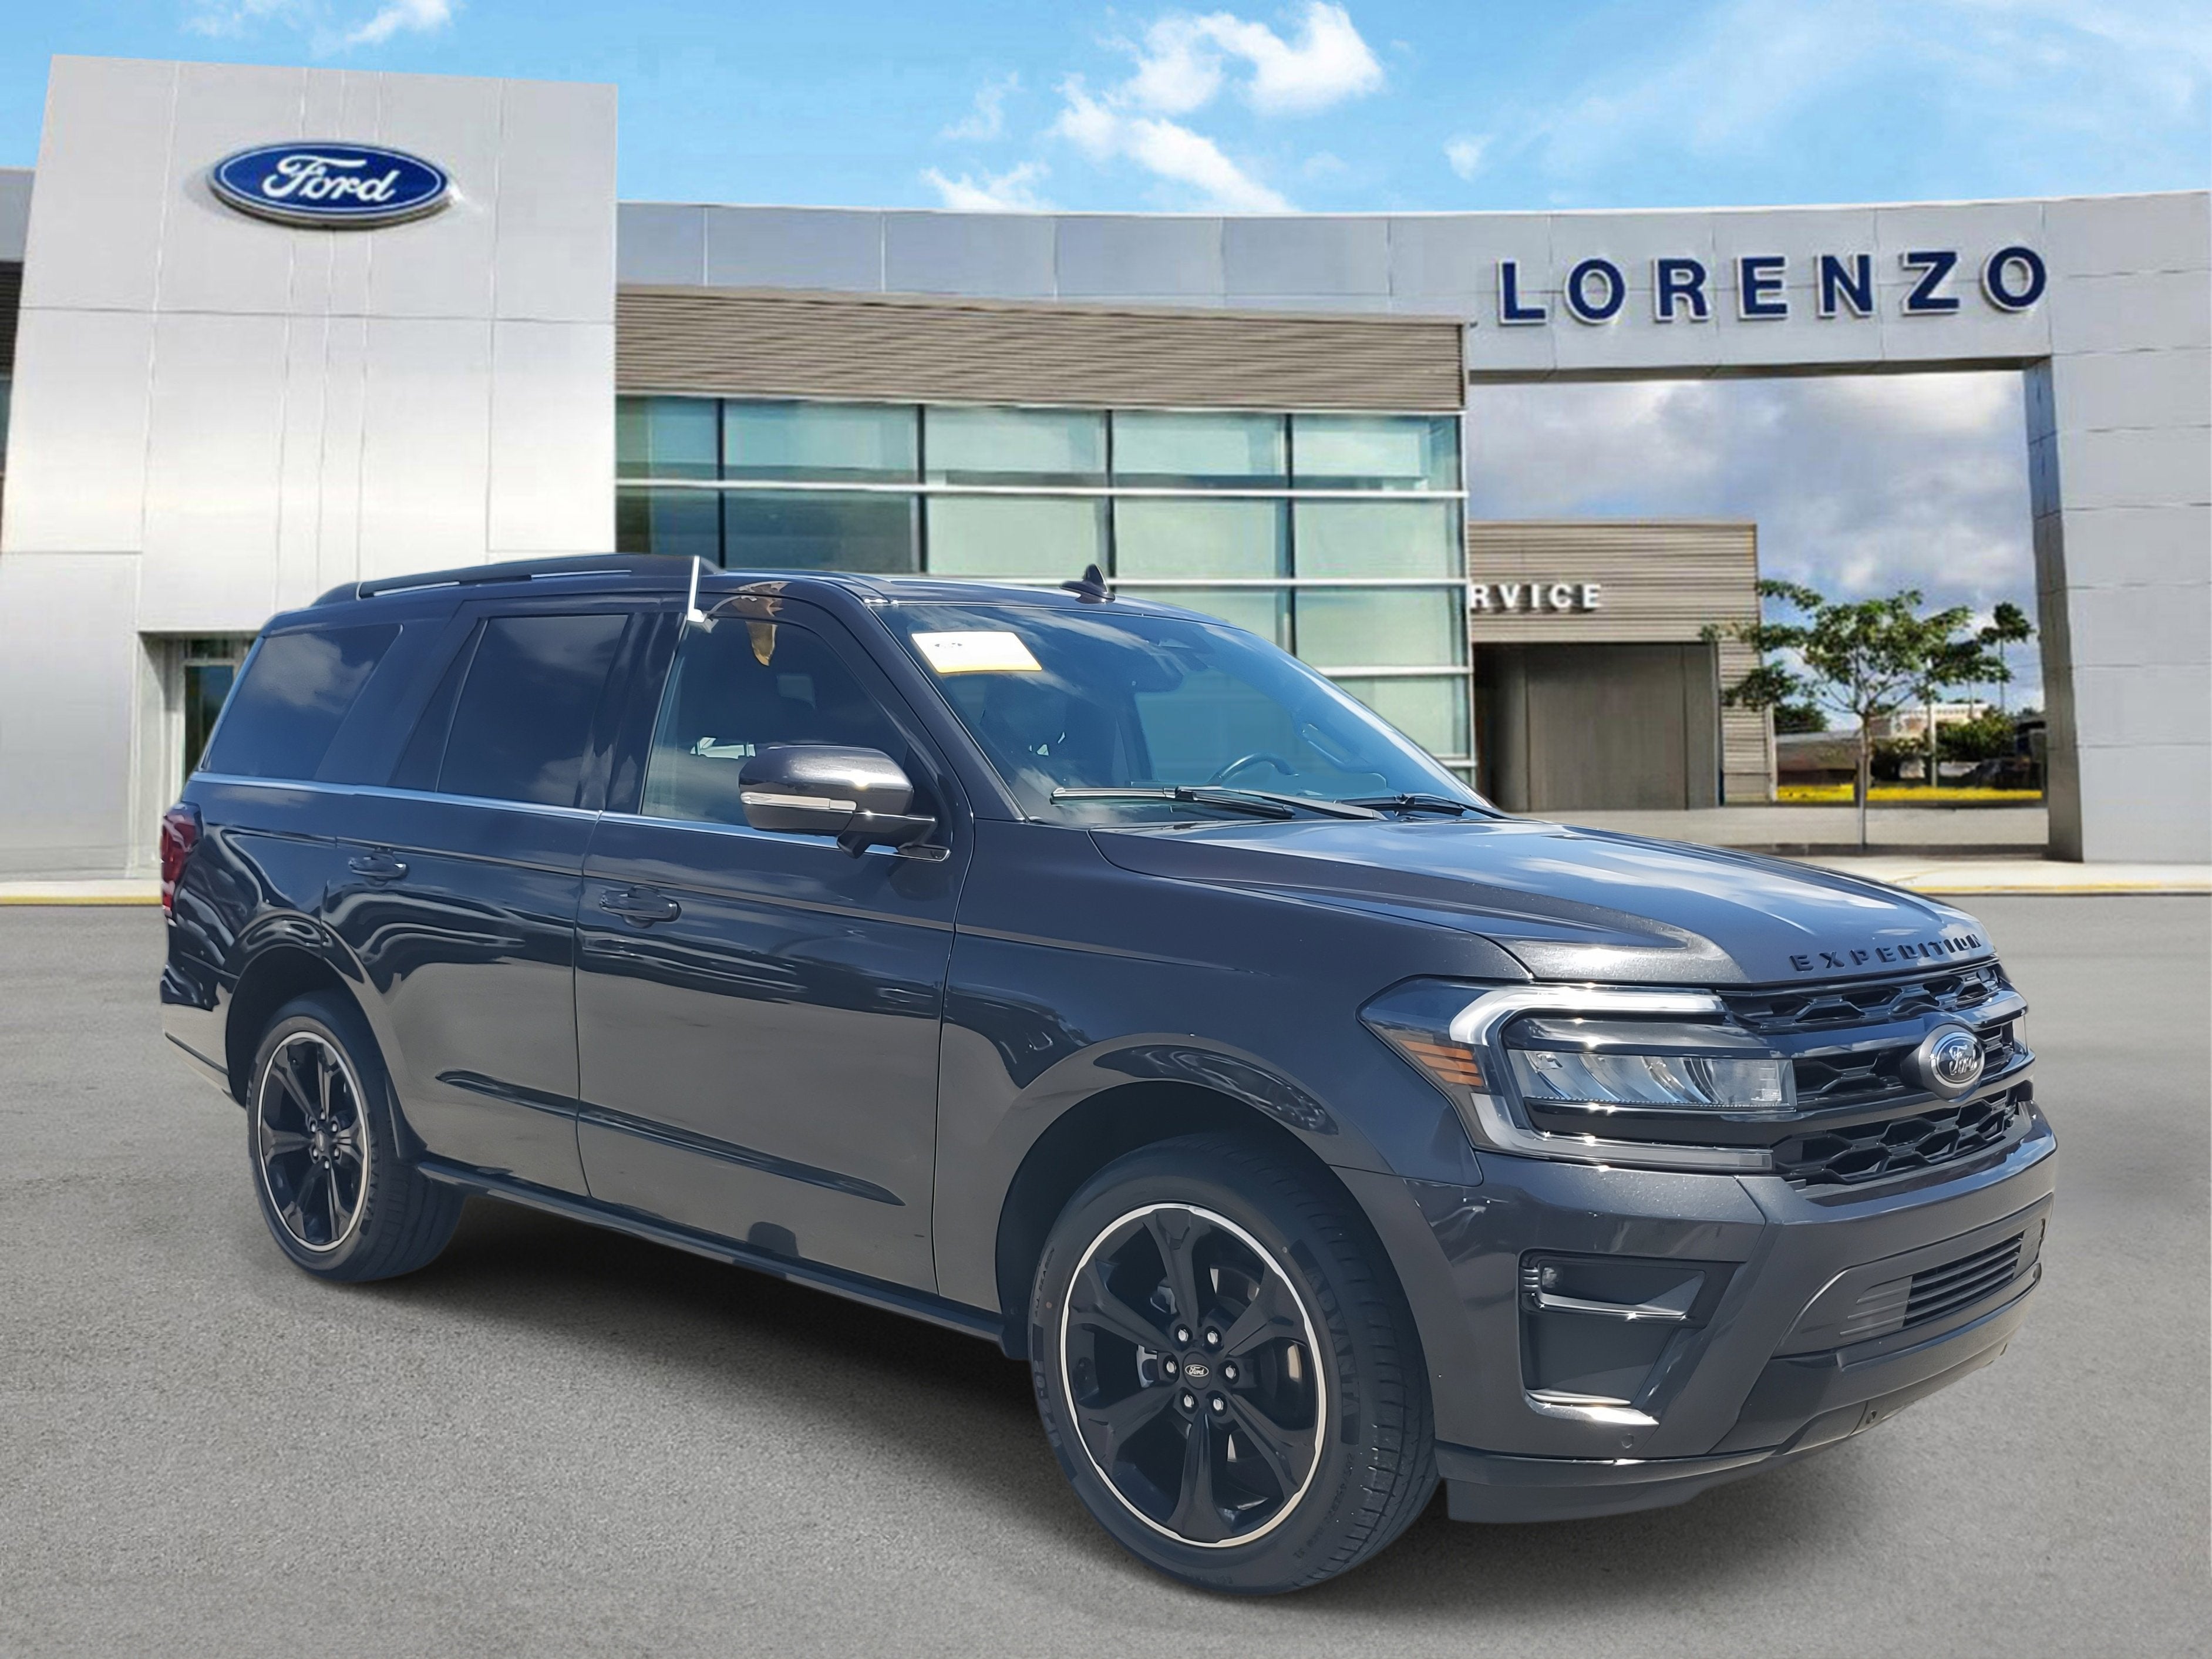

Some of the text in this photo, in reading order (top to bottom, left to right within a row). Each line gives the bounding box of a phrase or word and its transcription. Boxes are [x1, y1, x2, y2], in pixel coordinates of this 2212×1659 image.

[262, 154, 401, 203] Ford
[1497, 246, 2048, 327] LORENZO
[1469, 584, 1601, 609] RVICE
[1789, 934, 1982, 972] EXPEDITION
[1948, 1044, 1978, 1076] Ford
[1189, 1366, 1204, 1375] Ford
